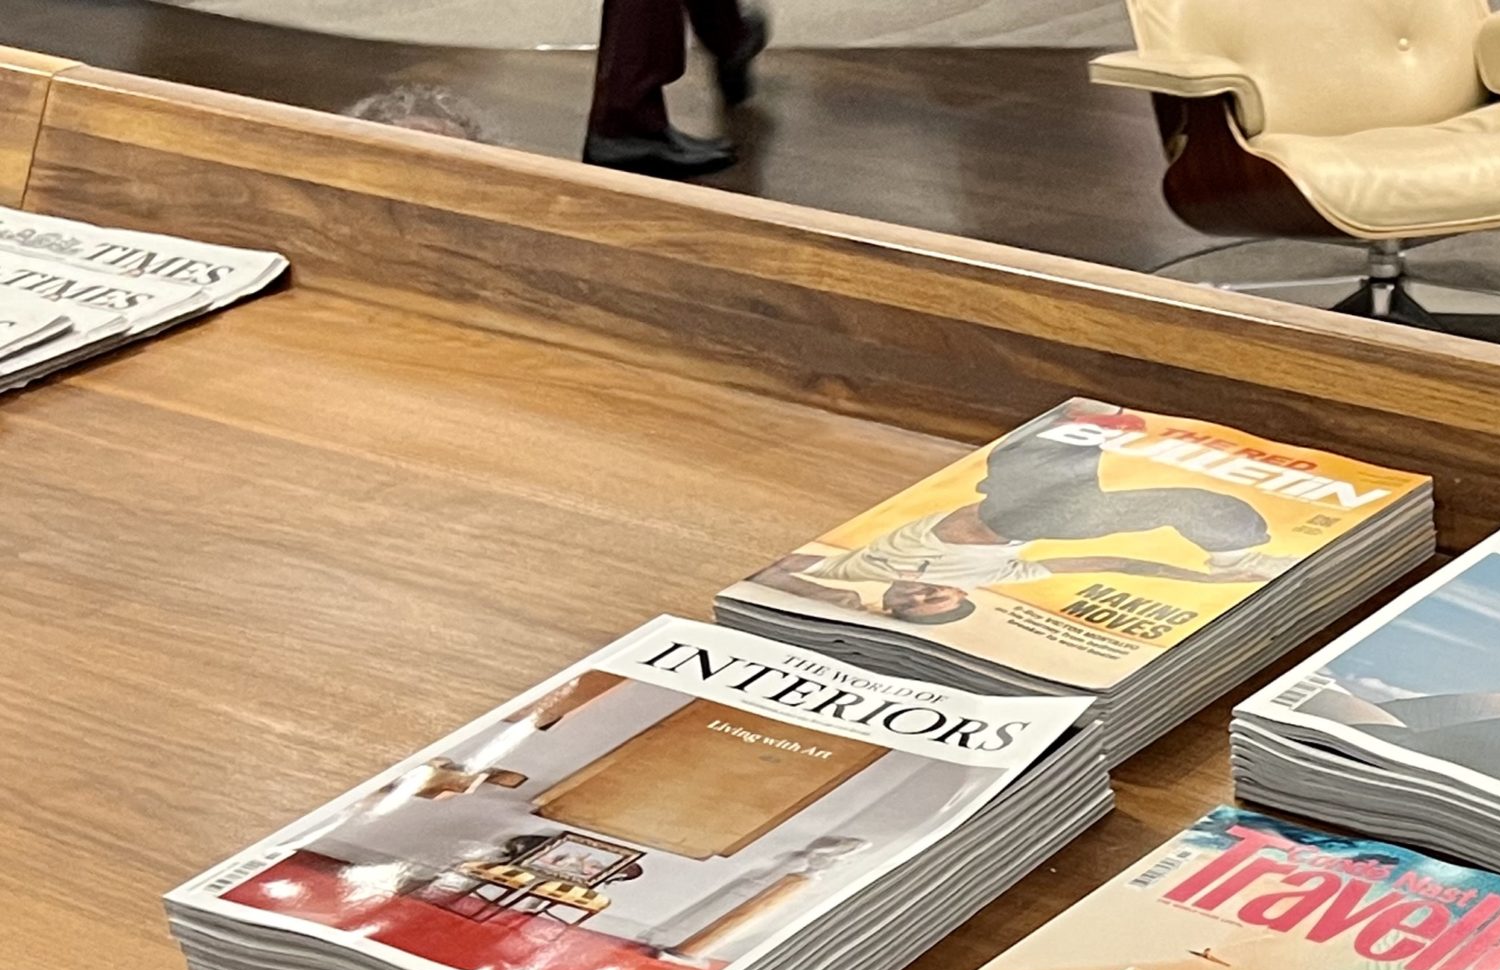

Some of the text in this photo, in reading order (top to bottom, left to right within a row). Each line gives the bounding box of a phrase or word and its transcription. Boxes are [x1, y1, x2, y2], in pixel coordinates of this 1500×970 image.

[86, 243, 234, 286] TIMES
[1, 269, 154, 310] TIMES
[1036, 423, 1392, 509] BULLETIN
[1161, 427, 1317, 472] THE RED
[1060, 600, 1173, 639] MOVES
[1076, 583, 1198, 625] MAKING
[640, 641, 1031, 753] INTERIORS
[781, 653, 950, 704] THE WORLD OF
[706, 719, 833, 760] Living with Art
[1393, 870, 1484, 907] Nast
